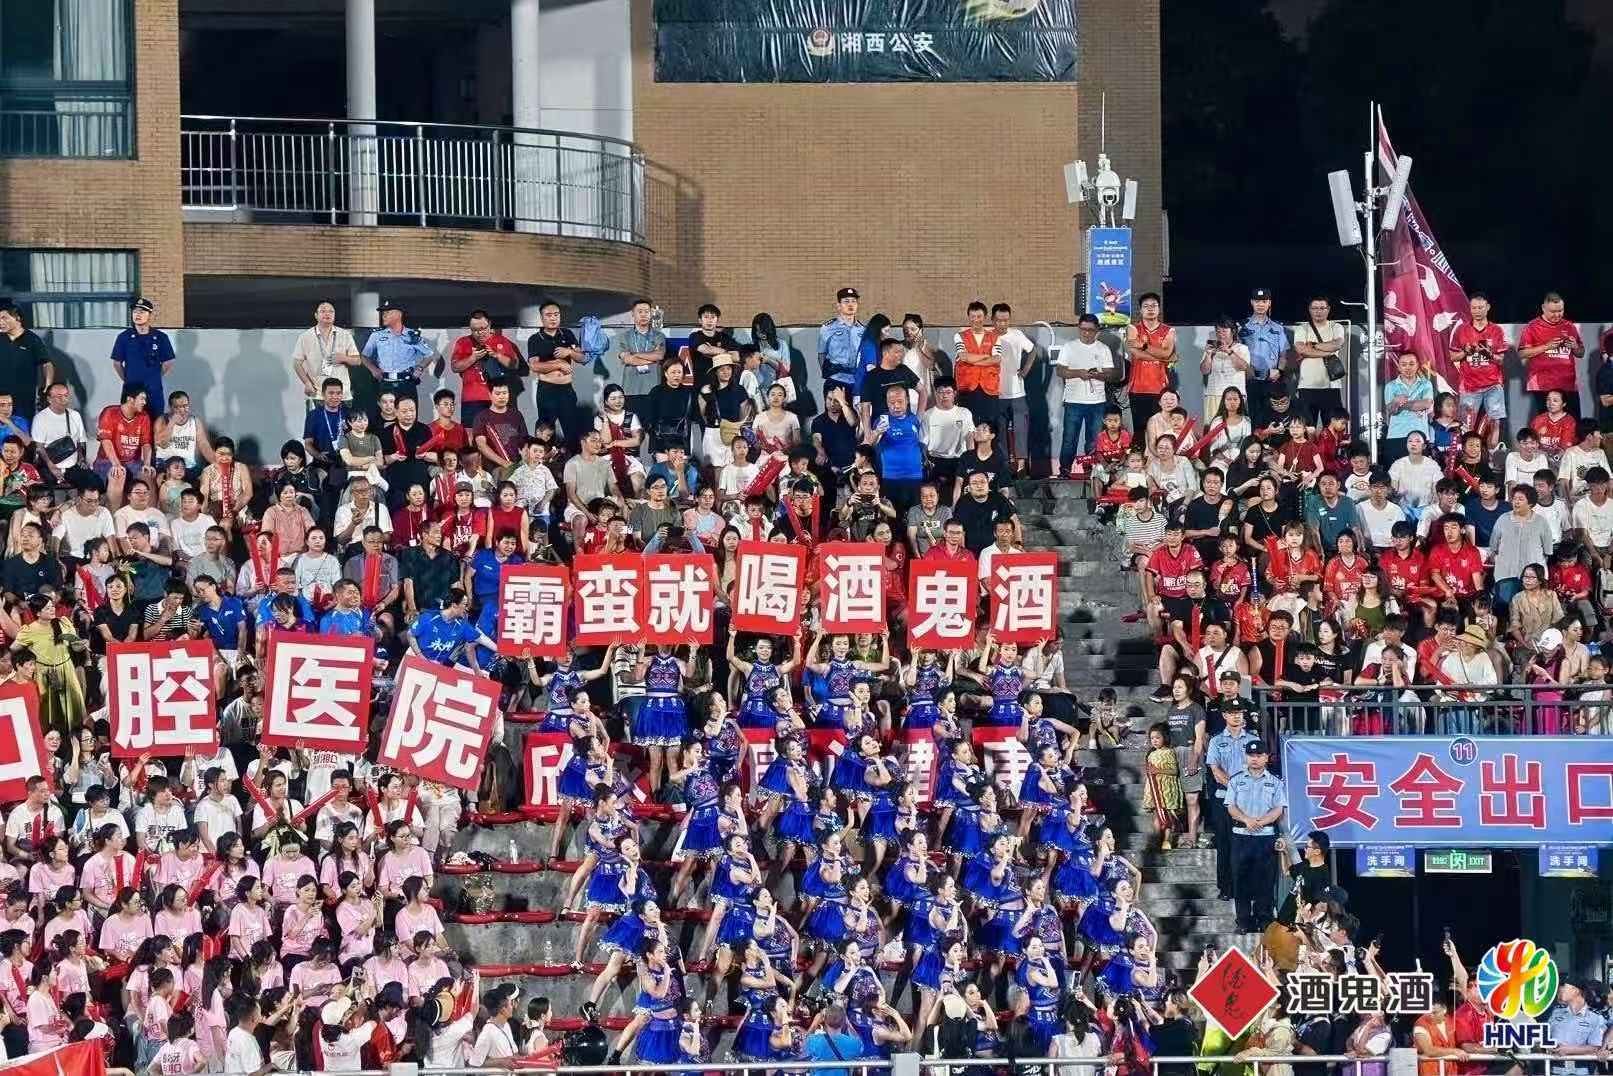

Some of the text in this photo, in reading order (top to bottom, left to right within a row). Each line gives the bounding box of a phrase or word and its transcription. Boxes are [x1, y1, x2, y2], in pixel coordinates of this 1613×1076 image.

[840, 31, 935, 53] 湘西公安
[503, 552, 1053, 646] 霸蛮就喝酒鬼酒
[1452, 742, 1473, 761] 11
[1305, 751, 1613, 831] 安全出口
[1367, 855, 1405, 867] 洗手间
[1549, 855, 1588, 867] 洗手间
